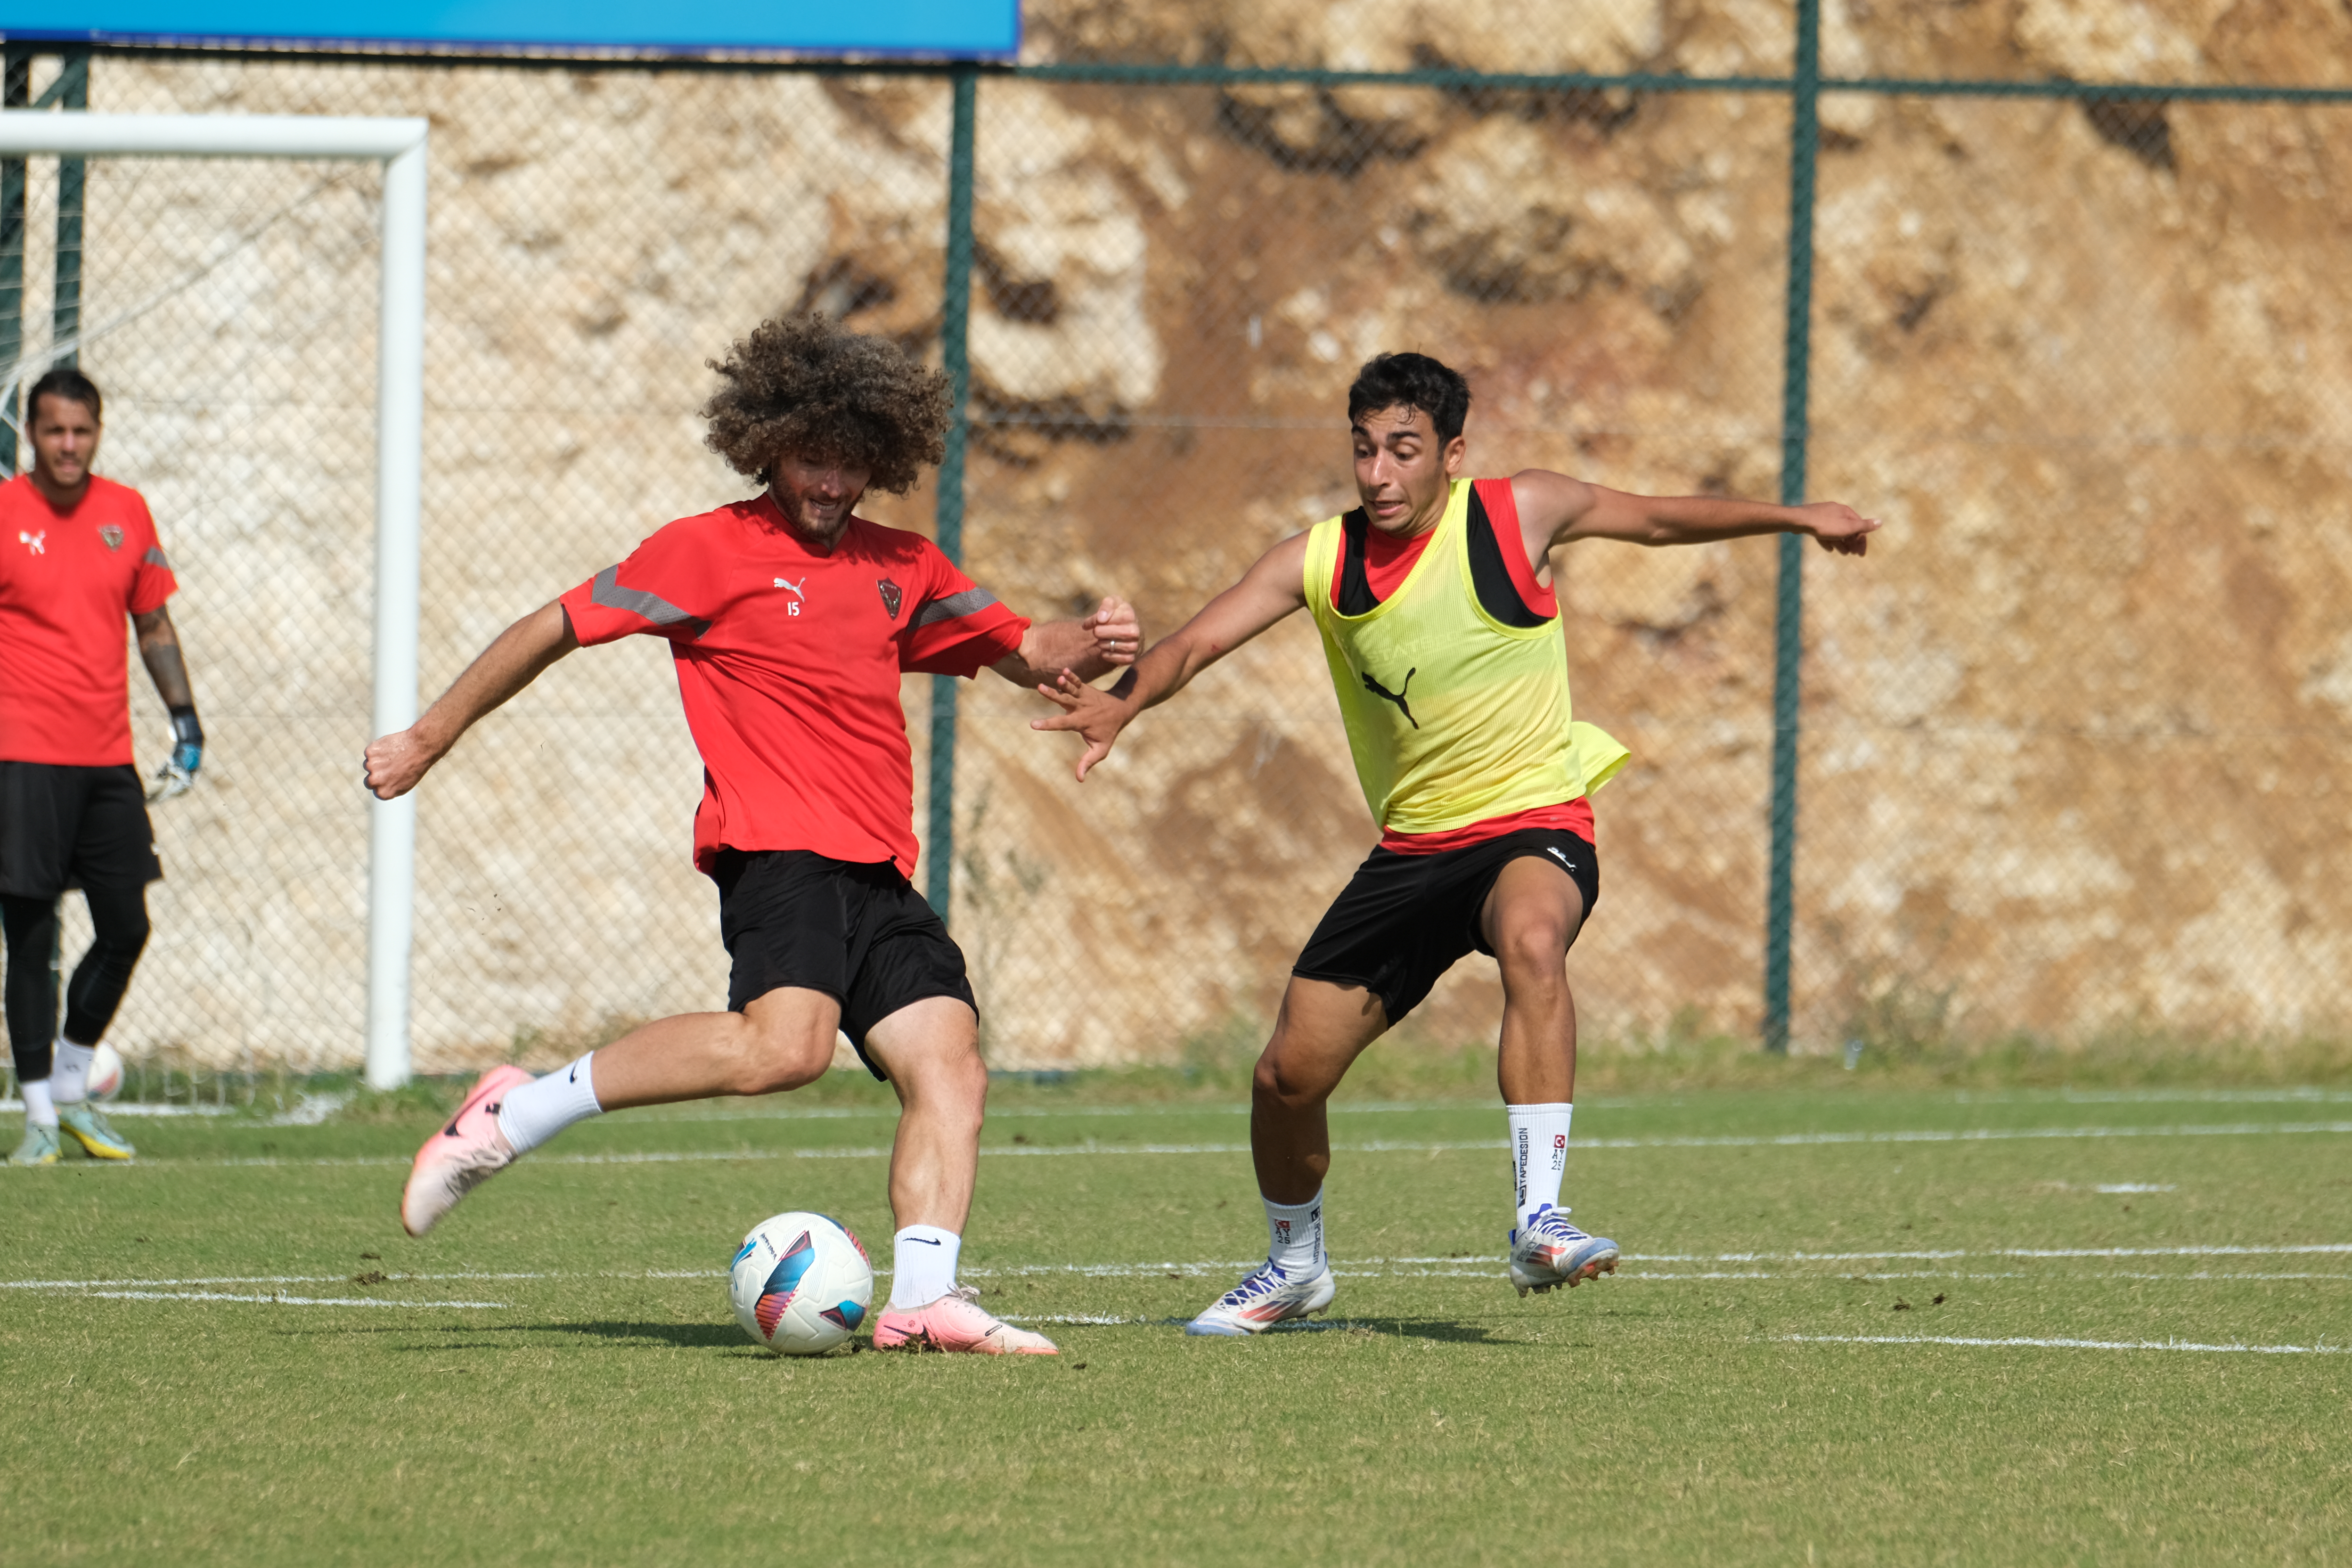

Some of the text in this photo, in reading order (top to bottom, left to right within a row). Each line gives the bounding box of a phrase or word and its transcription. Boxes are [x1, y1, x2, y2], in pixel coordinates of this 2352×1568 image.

[787, 601, 800, 616] 15
[1518, 1128, 1528, 1185] TAPEDESIGN
[1552, 1149, 1564, 1160] AY
[1275, 1227, 1290, 1237] AY
[1277, 1236, 1290, 1244] 25
